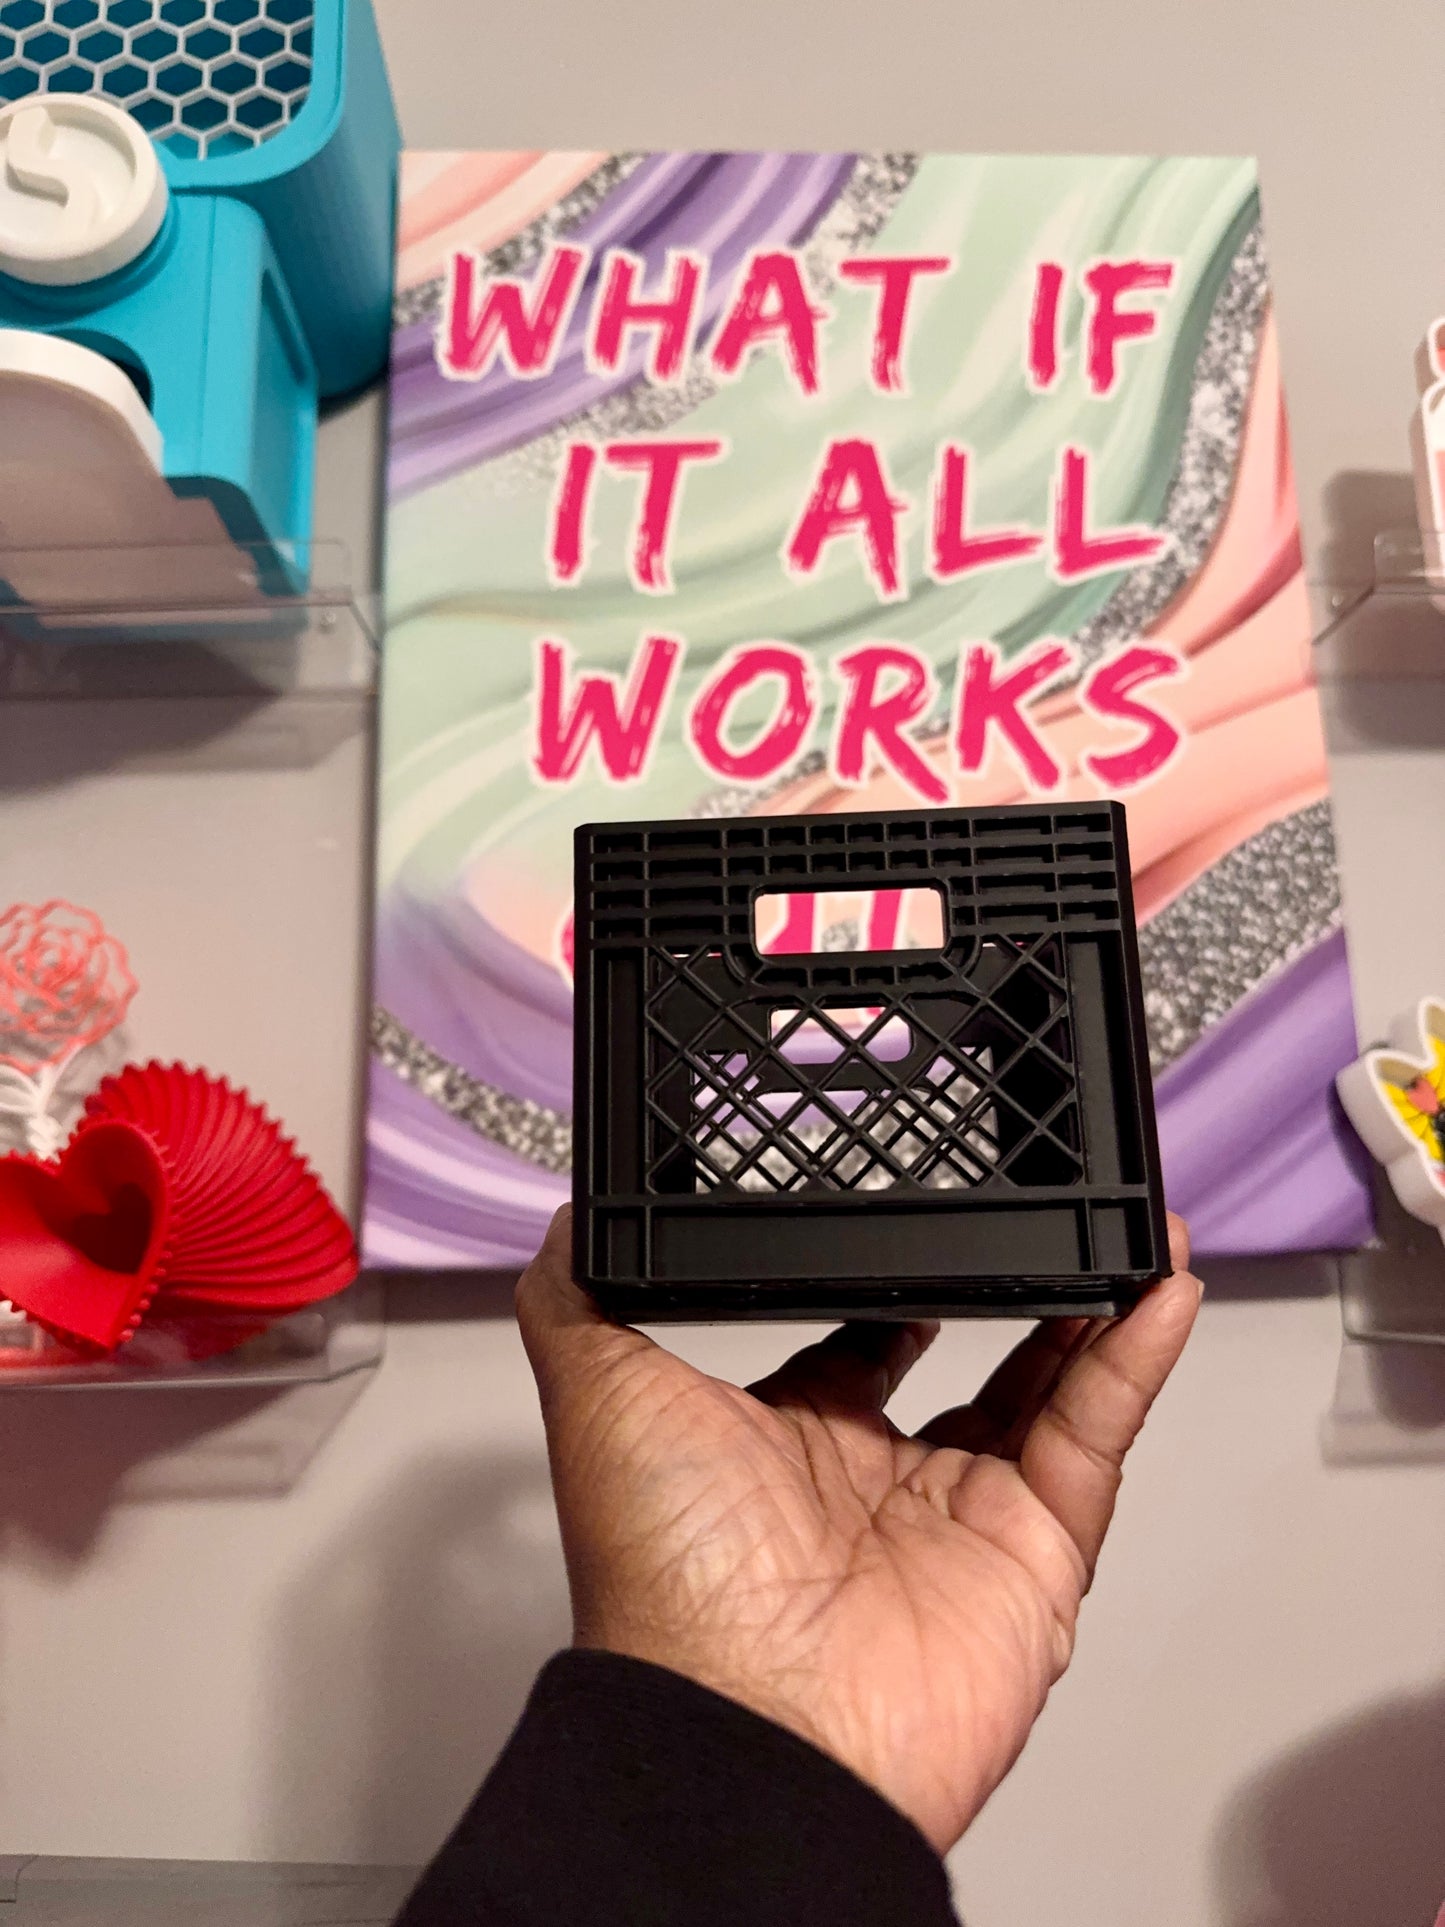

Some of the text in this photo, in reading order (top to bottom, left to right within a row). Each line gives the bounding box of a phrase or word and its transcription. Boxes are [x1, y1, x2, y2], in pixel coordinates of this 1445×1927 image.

[444, 247, 1174, 393] WHAT IF
[551, 438, 1163, 594] IT ALL
[533, 636, 1182, 803] WORKS
